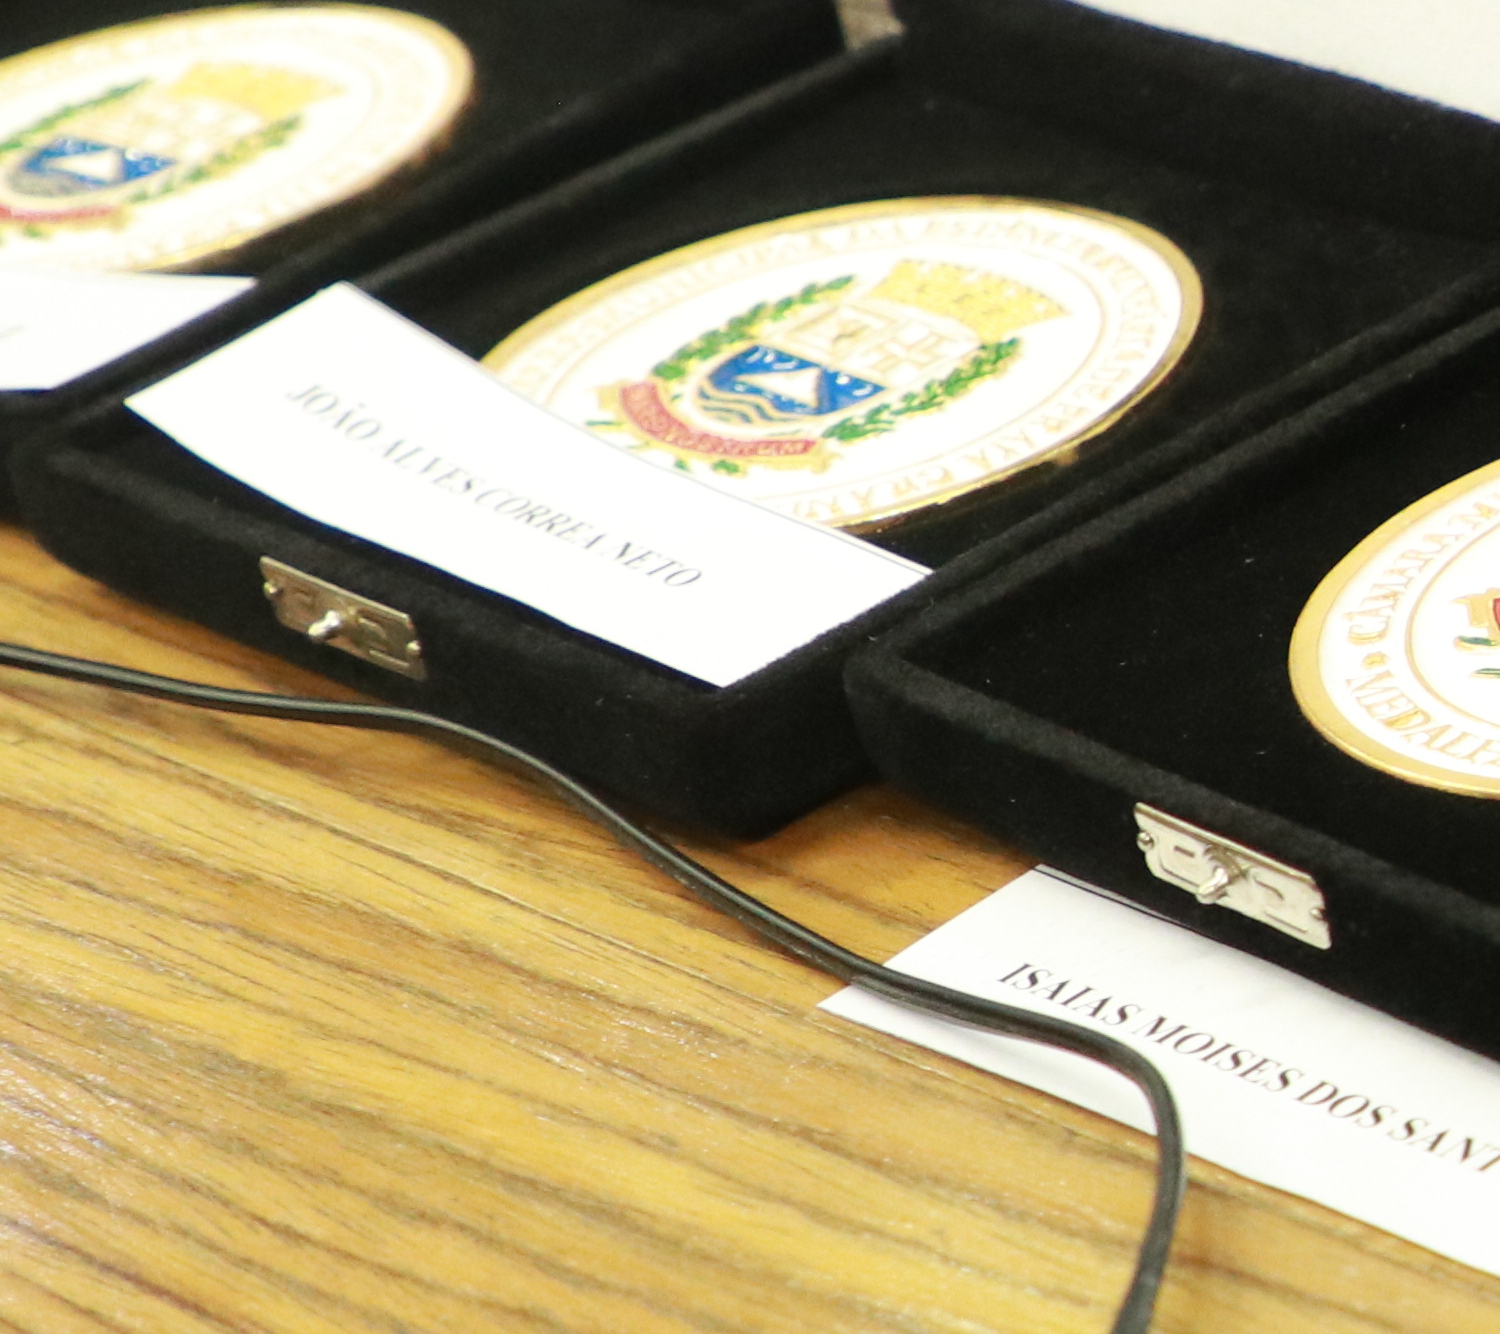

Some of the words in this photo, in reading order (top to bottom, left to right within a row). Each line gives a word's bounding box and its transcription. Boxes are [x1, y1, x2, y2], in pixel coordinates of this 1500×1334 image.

[285, 383, 384, 443] JOÃO
[374, 437, 484, 496] ALVES
[473, 487, 608, 551] CORREA
[605, 540, 703, 588] NETO
[996, 962, 1146, 1027] ISAIAS
[1129, 1013, 1306, 1094] MOISES
[1291, 1077, 1397, 1131] DOS
